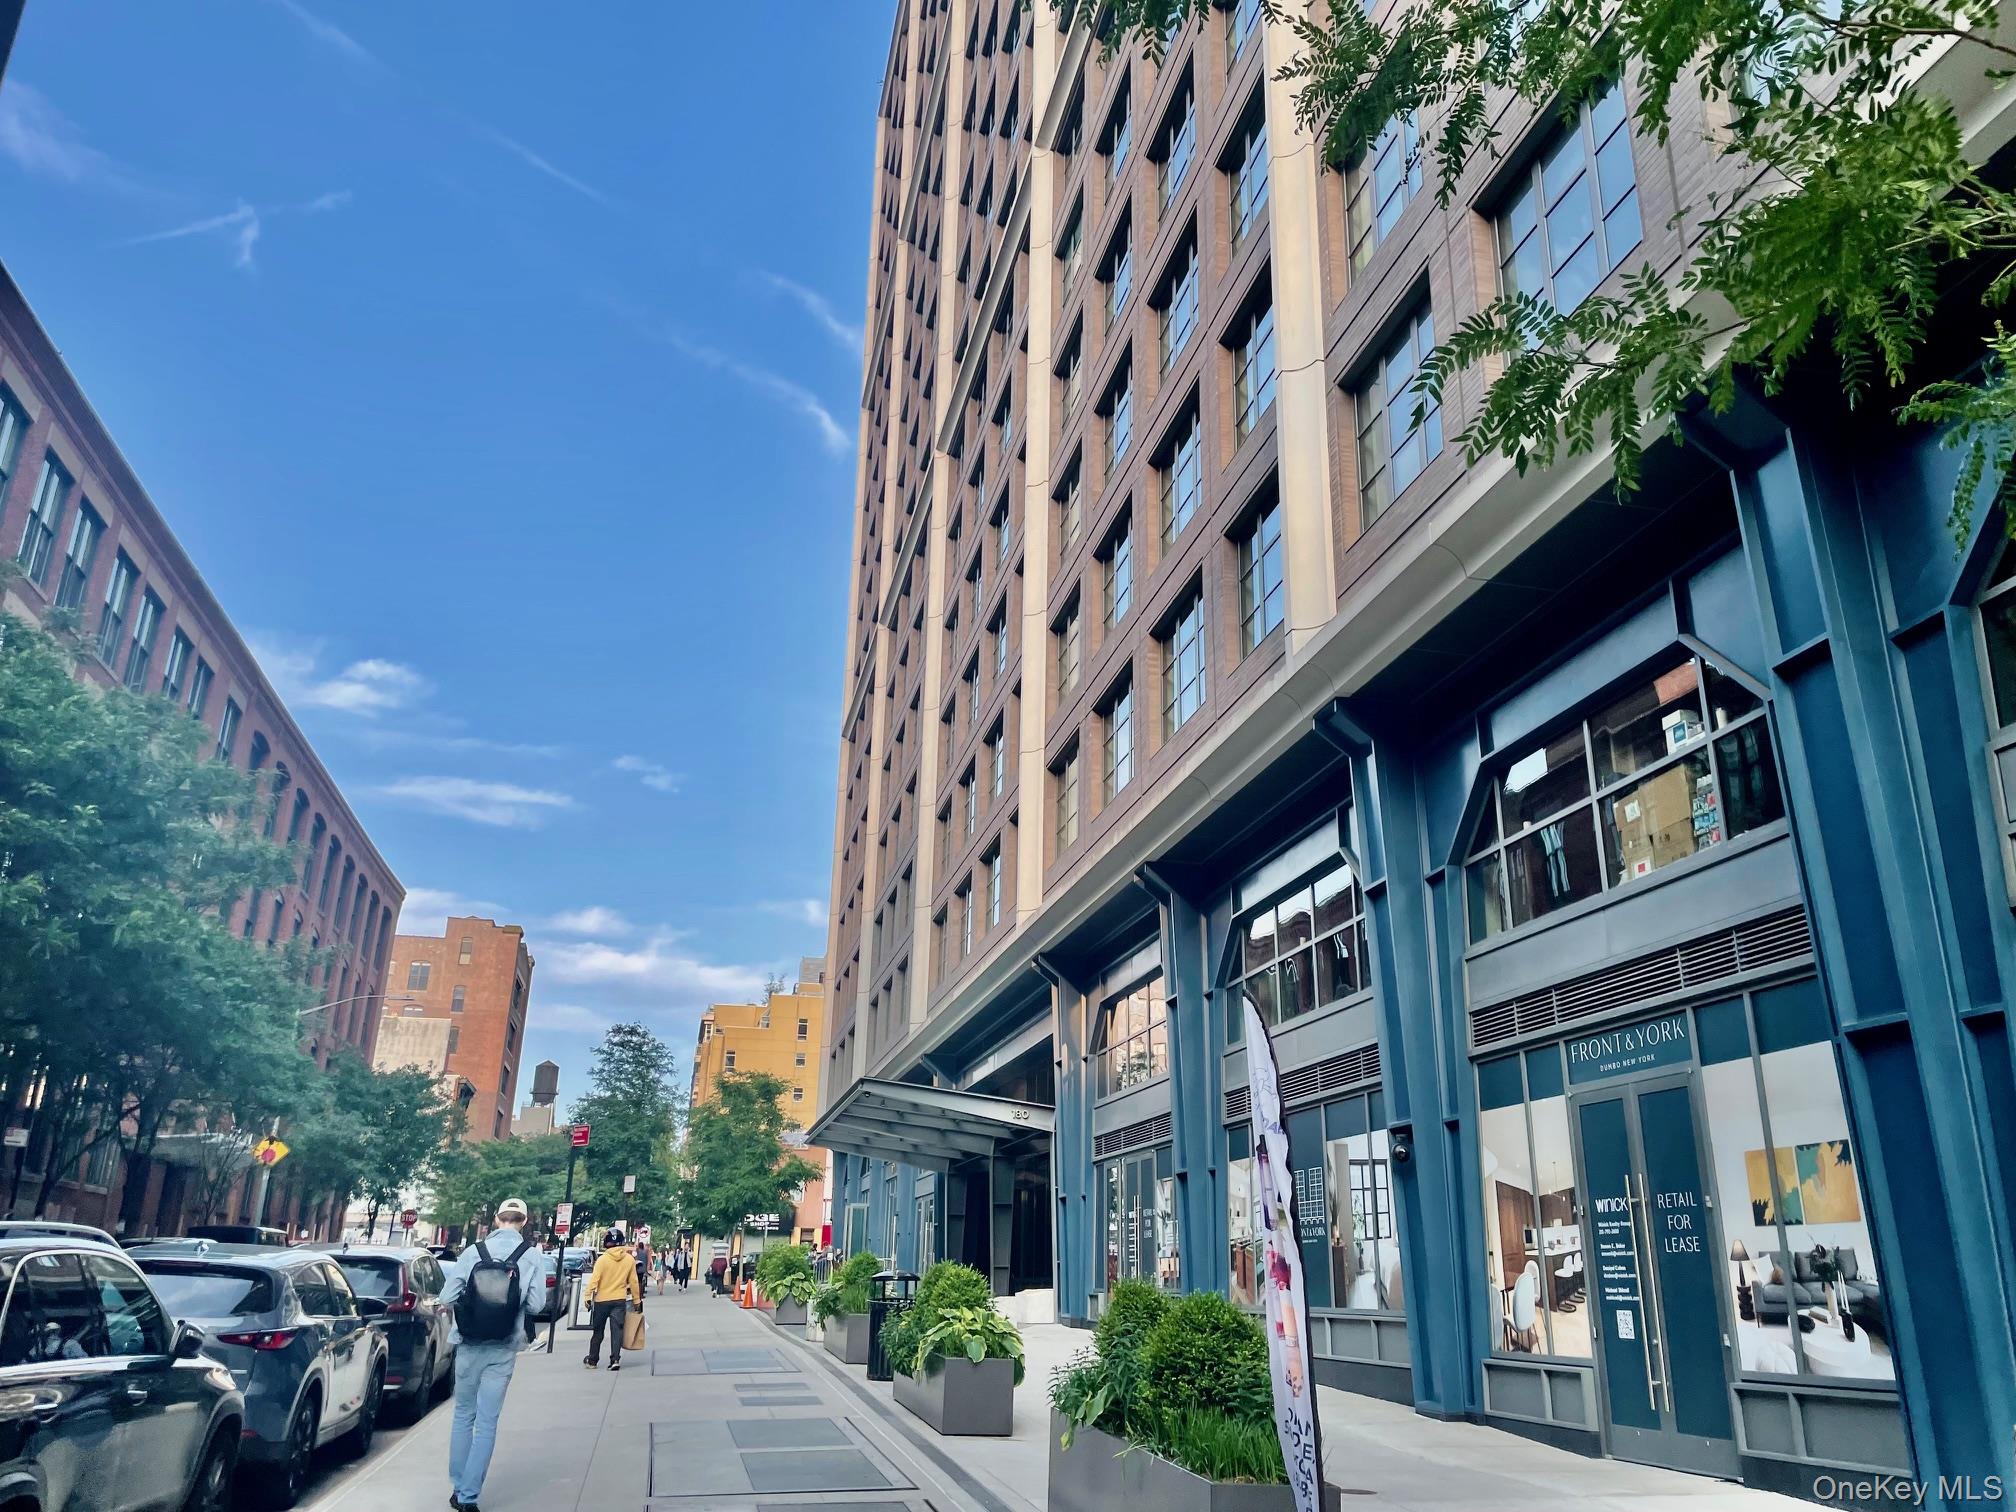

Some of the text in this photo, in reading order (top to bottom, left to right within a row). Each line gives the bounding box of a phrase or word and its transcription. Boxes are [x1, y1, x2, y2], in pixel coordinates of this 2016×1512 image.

[1599, 1053, 1656, 1072] DUMBO NEW YORK
[1011, 1109, 1029, 1120] 180
[1657, 1191, 1698, 1209] RETAIL
[401, 1213, 417, 1222] STOP
[1667, 1214, 1692, 1230] FOR
[1664, 1236, 1701, 1253] LEASE
